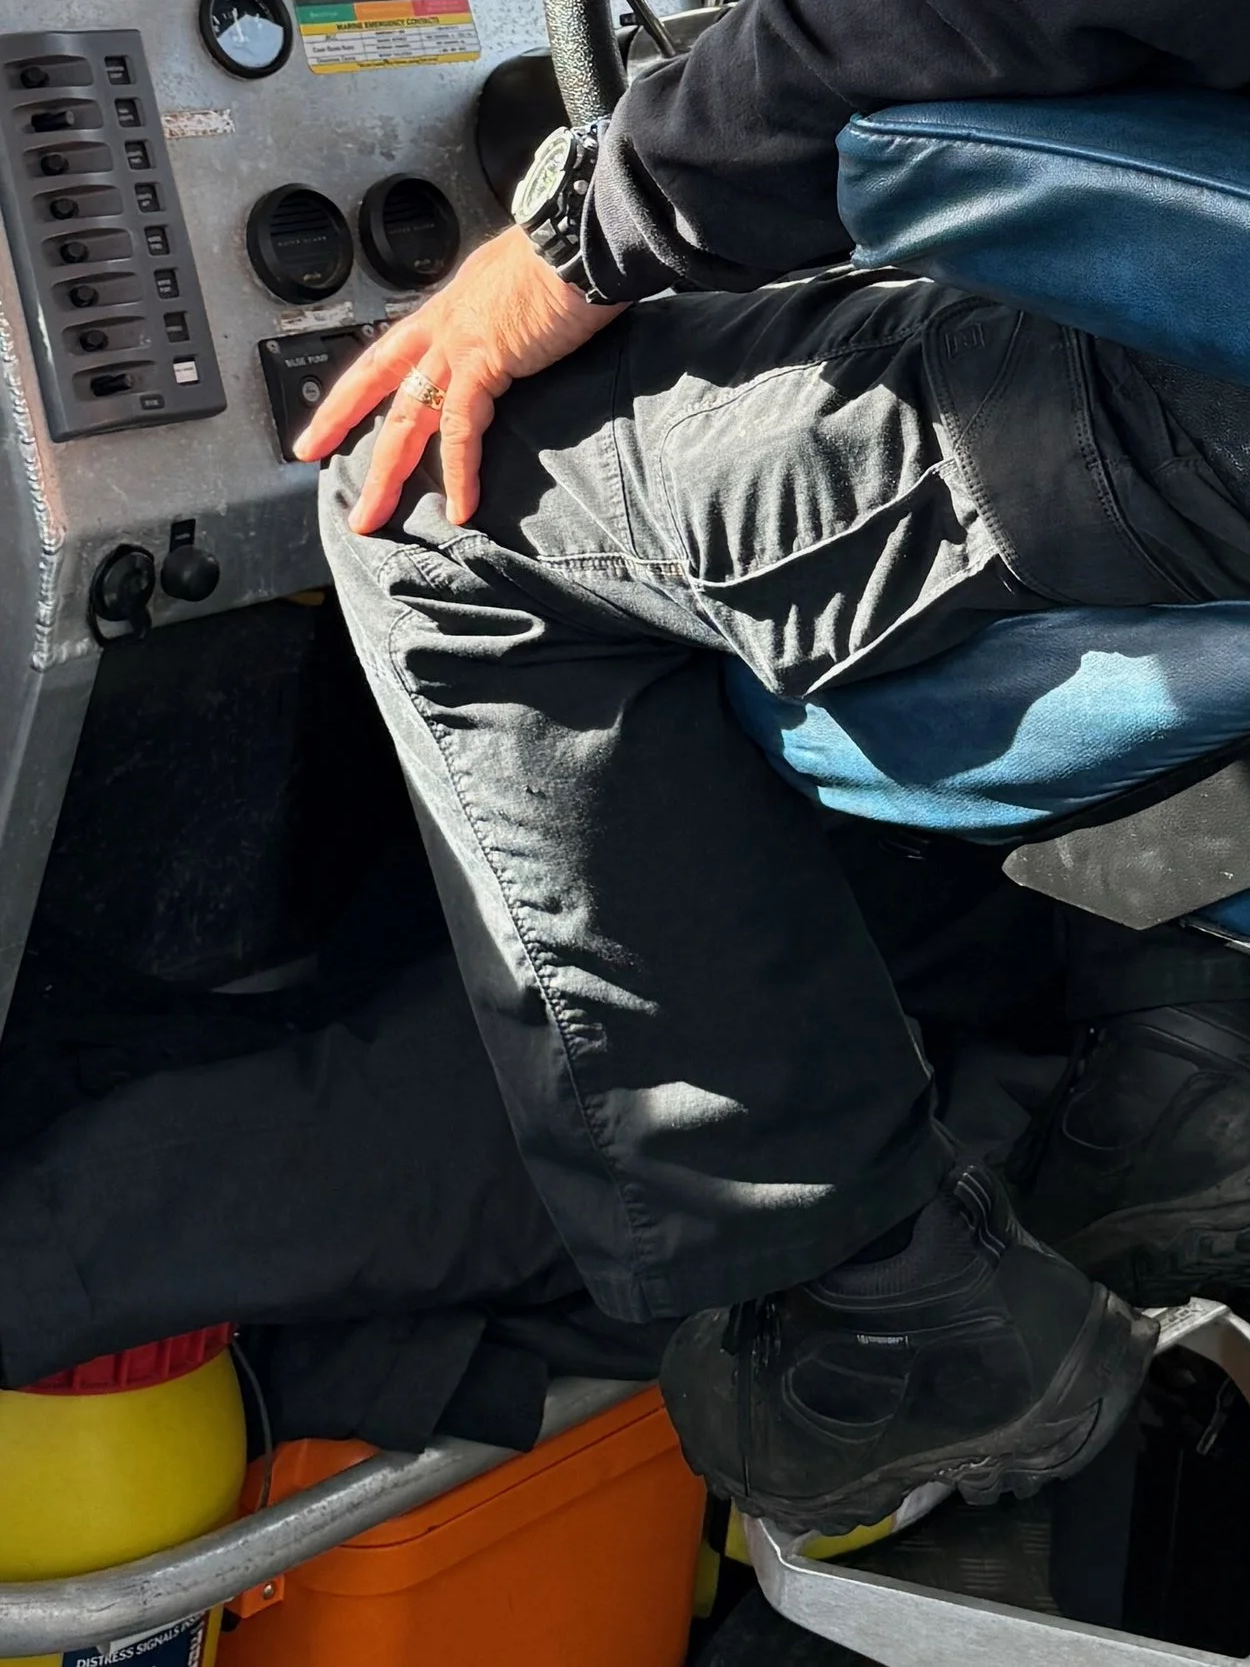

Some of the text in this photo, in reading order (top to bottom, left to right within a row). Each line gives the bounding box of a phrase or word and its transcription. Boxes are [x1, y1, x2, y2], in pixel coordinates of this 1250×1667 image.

[307, 353, 329, 366] PUMP
[76, 1646, 135, 1667] DISTRESS
[135, 1626, 182, 1656] SIGNALS
